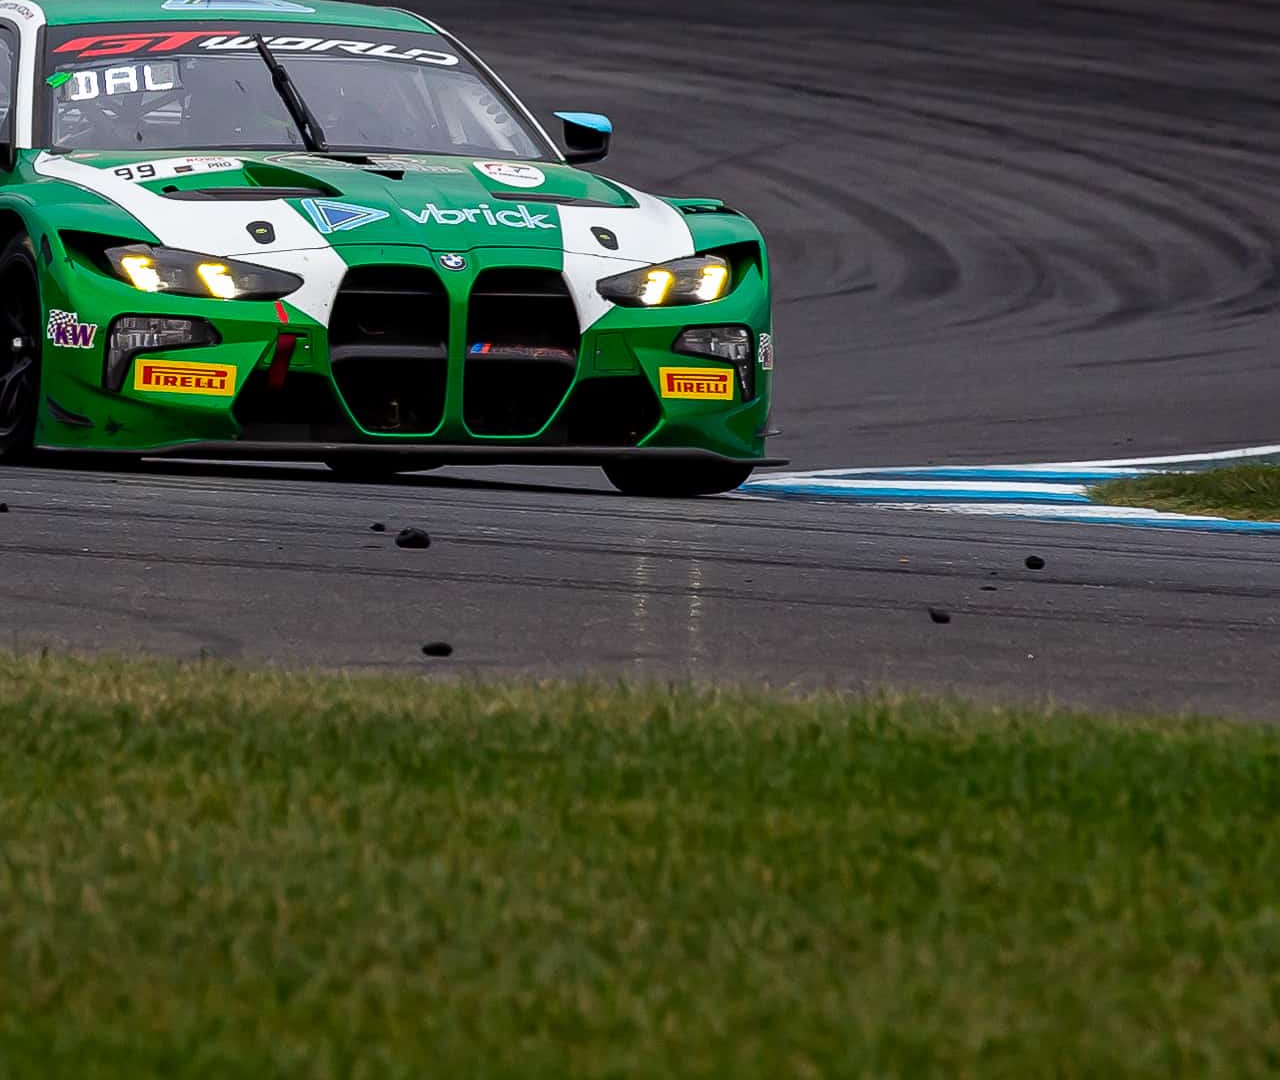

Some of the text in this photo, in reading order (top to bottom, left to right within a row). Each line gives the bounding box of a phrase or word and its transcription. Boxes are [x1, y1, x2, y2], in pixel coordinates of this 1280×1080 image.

[69, 63, 174, 101] DAL
[113, 163, 156, 181] 99
[400, 202, 560, 230] vbrick
[53, 321, 97, 348] KW
[142, 365, 229, 390] PIRELLI
[666, 372, 728, 394] PIRELLI
